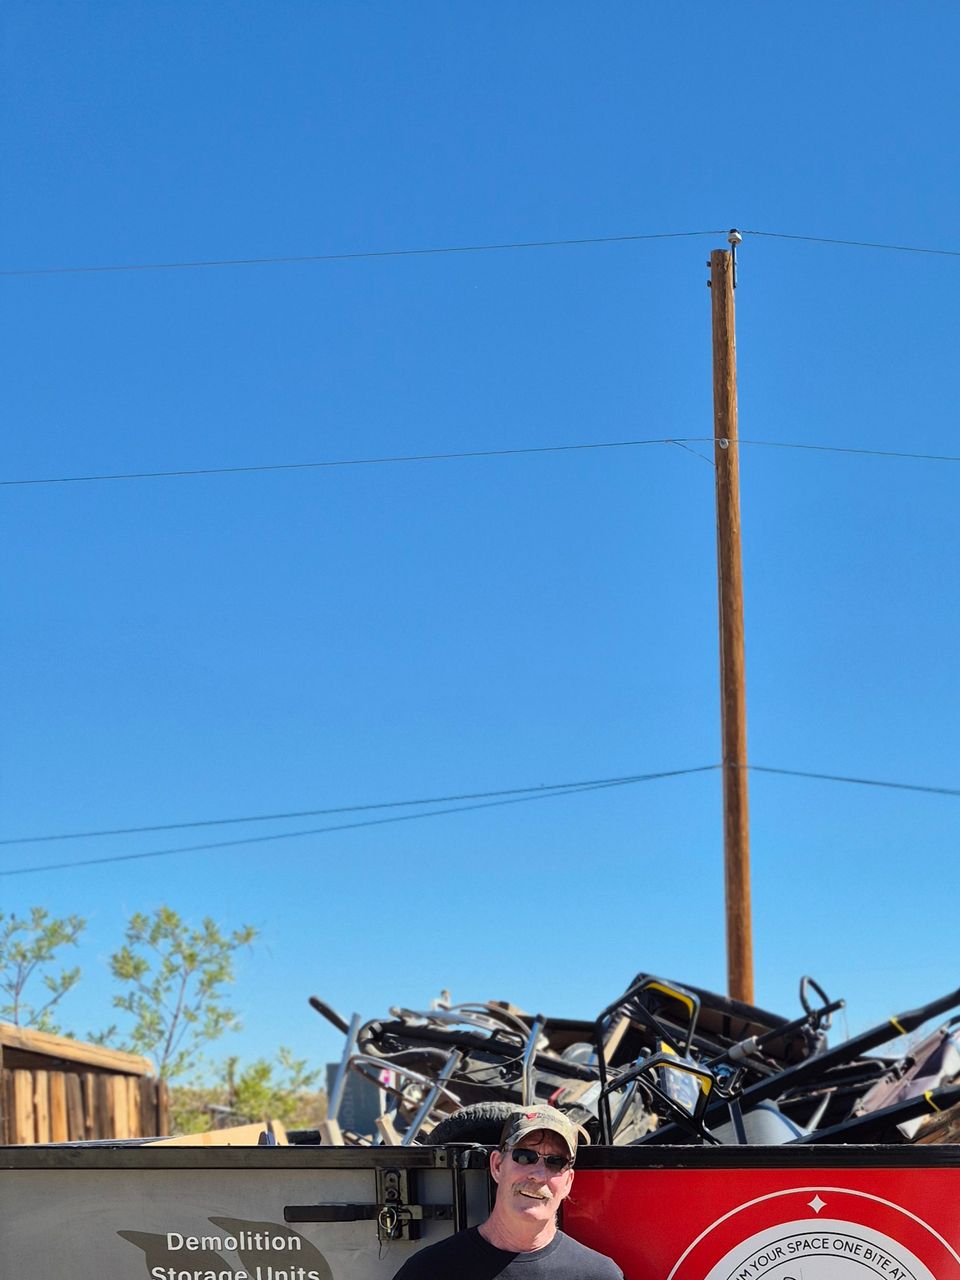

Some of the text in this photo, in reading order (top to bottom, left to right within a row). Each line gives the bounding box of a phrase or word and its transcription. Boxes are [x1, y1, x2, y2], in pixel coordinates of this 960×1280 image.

[167, 1232, 302, 1252] Demolition
[749, 1246, 787, 1271] YOUR
[786, 1237, 830, 1254] SPACE
[832, 1238, 863, 1256] ONE
[863, 1248, 892, 1271] BITE
